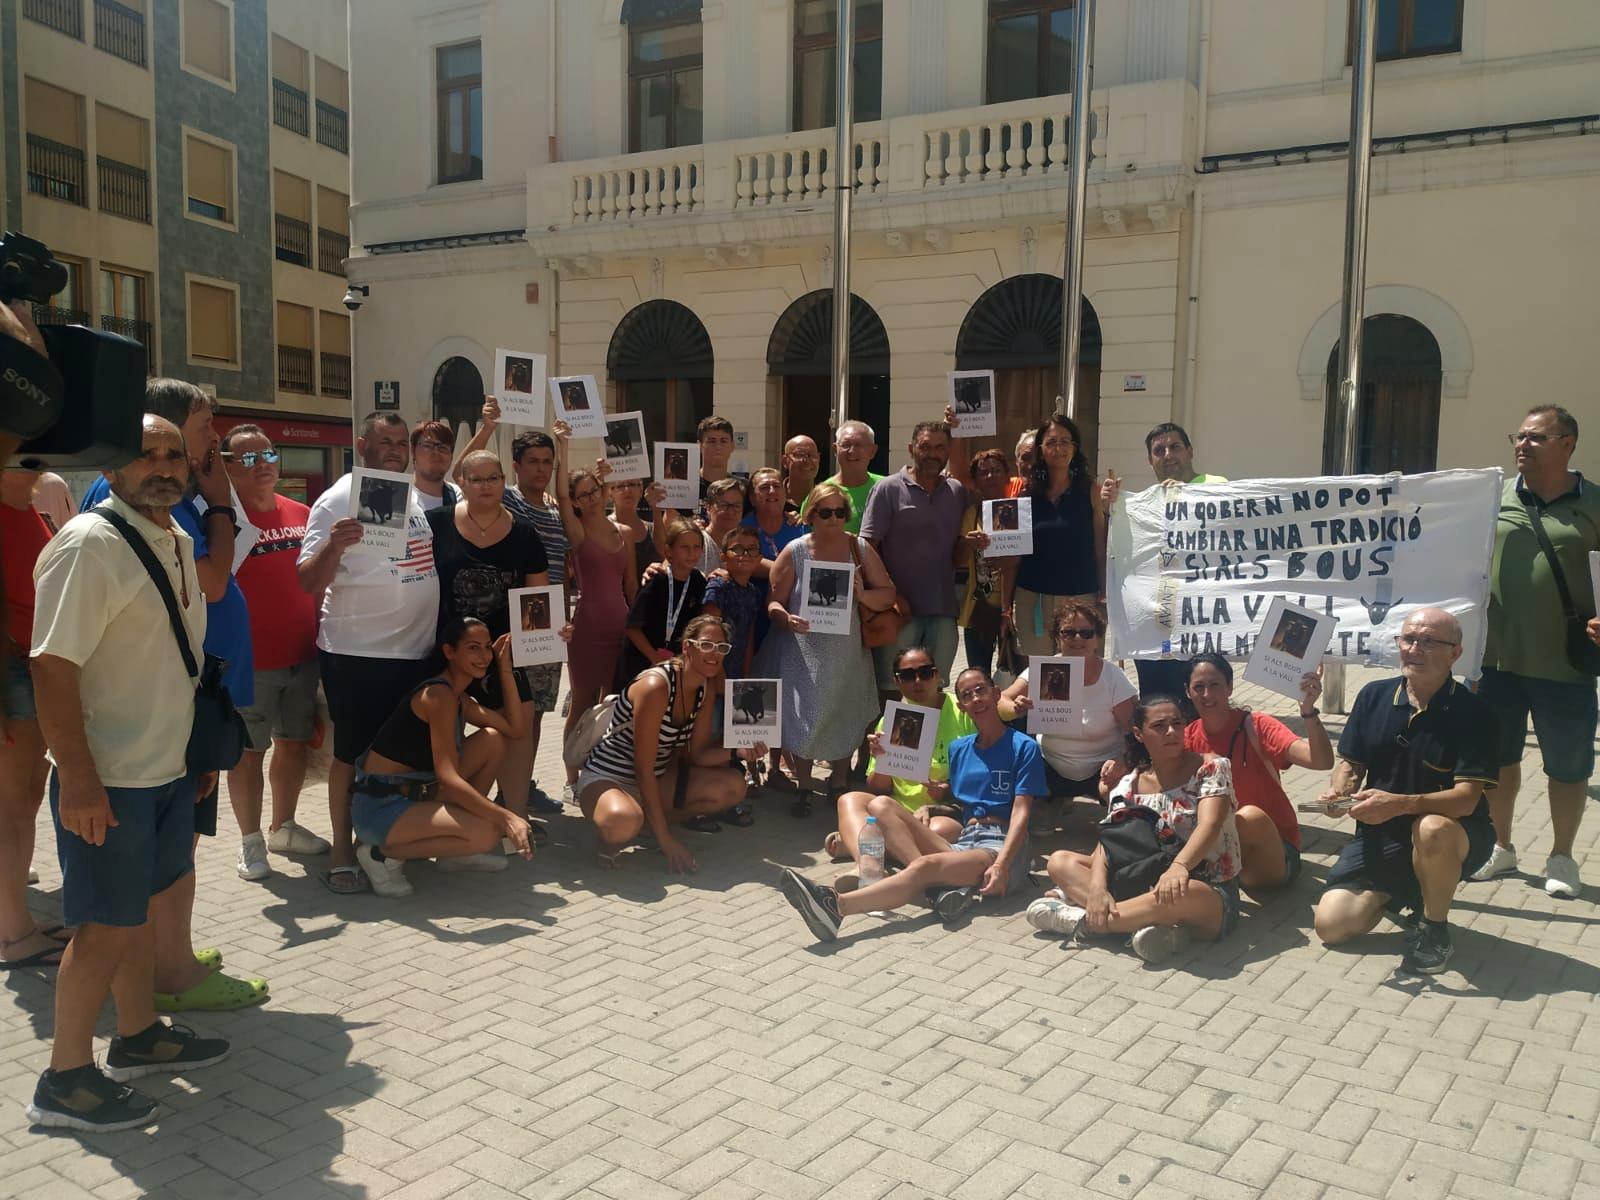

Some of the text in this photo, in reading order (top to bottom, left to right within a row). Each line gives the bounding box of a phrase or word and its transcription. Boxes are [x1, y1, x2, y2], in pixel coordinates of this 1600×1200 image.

[3, 368, 50, 407] SONY
[1165, 501, 1188, 521] UN
[1292, 489, 1330, 513] NO
[1338, 486, 1393, 508] POT
[1167, 506, 1422, 552] CAMBIAR UNA TRADICIÓ
[1287, 546, 1393, 580] BOUS
